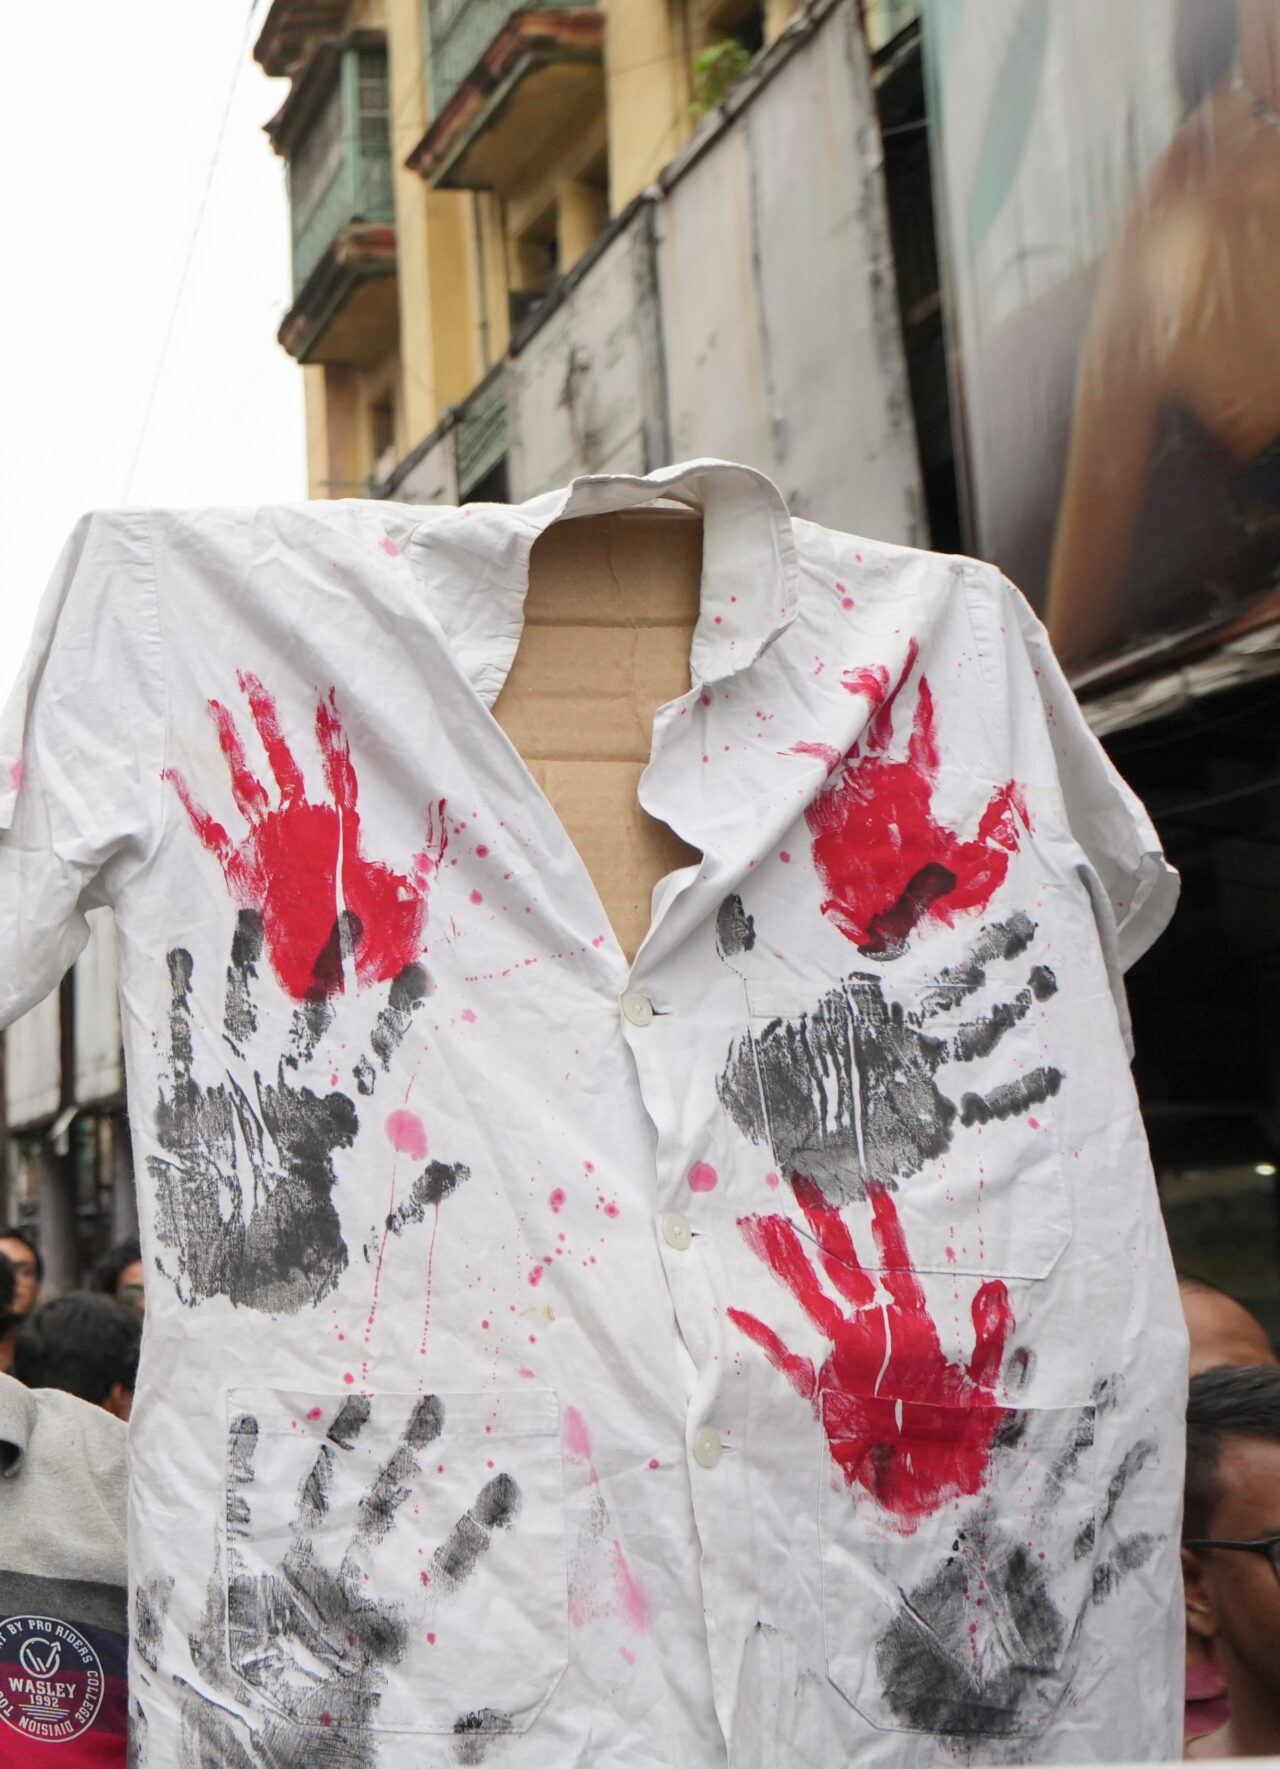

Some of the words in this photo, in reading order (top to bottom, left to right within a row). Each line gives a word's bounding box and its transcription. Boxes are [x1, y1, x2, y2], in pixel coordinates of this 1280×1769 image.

[6, 1621, 23, 1635] BY
[28, 1619, 52, 1633] PRO
[55, 1625, 93, 1664] RIDERS
[8, 1677, 76, 1699] WASLEY
[75, 1670, 99, 1724] COLLEGE
[29, 1694, 59, 1708] 1992
[18, 1716, 75, 1737] DIVISION
